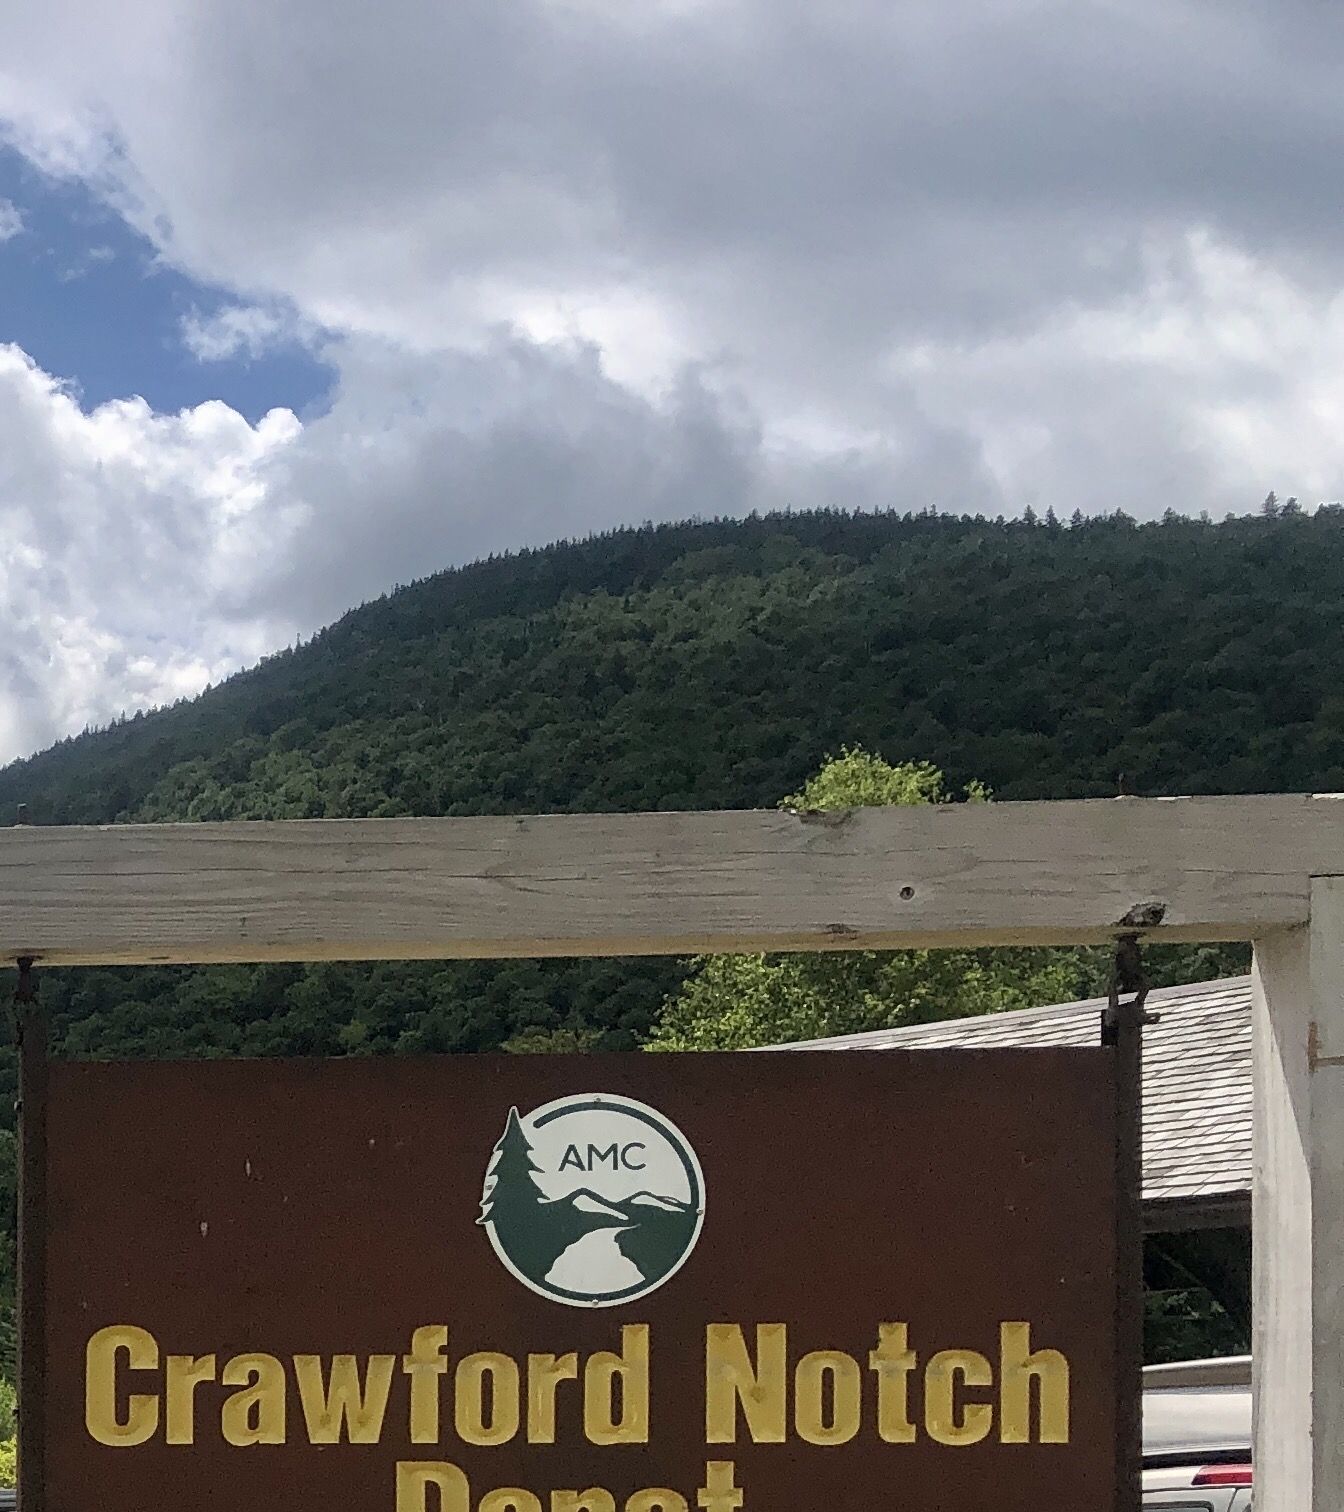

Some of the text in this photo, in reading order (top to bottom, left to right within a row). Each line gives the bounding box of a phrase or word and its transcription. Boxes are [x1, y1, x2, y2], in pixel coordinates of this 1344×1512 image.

[558, 1142, 646, 1172] AMC
[85, 1321, 1070, 1446] Crawford Notch
